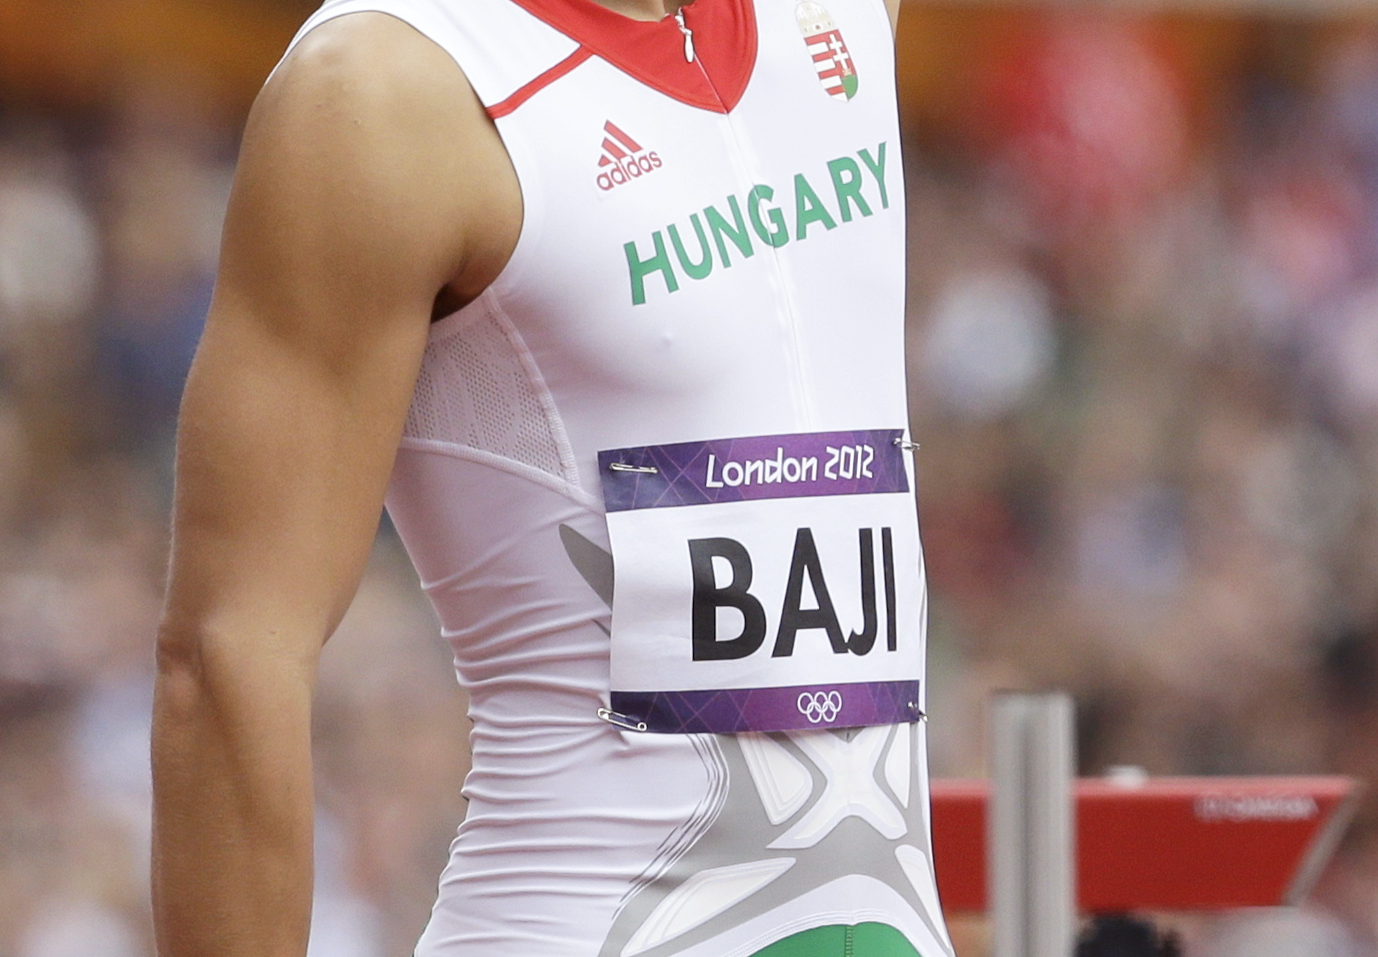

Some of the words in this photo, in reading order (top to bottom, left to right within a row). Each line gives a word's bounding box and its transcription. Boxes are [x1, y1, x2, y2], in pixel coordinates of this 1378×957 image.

[596, 150, 662, 191] adidas
[623, 141, 889, 305] HUNGARY
[706, 447, 817, 487] London
[824, 445, 874, 481] 2012
[687, 527, 897, 661] BAJI
